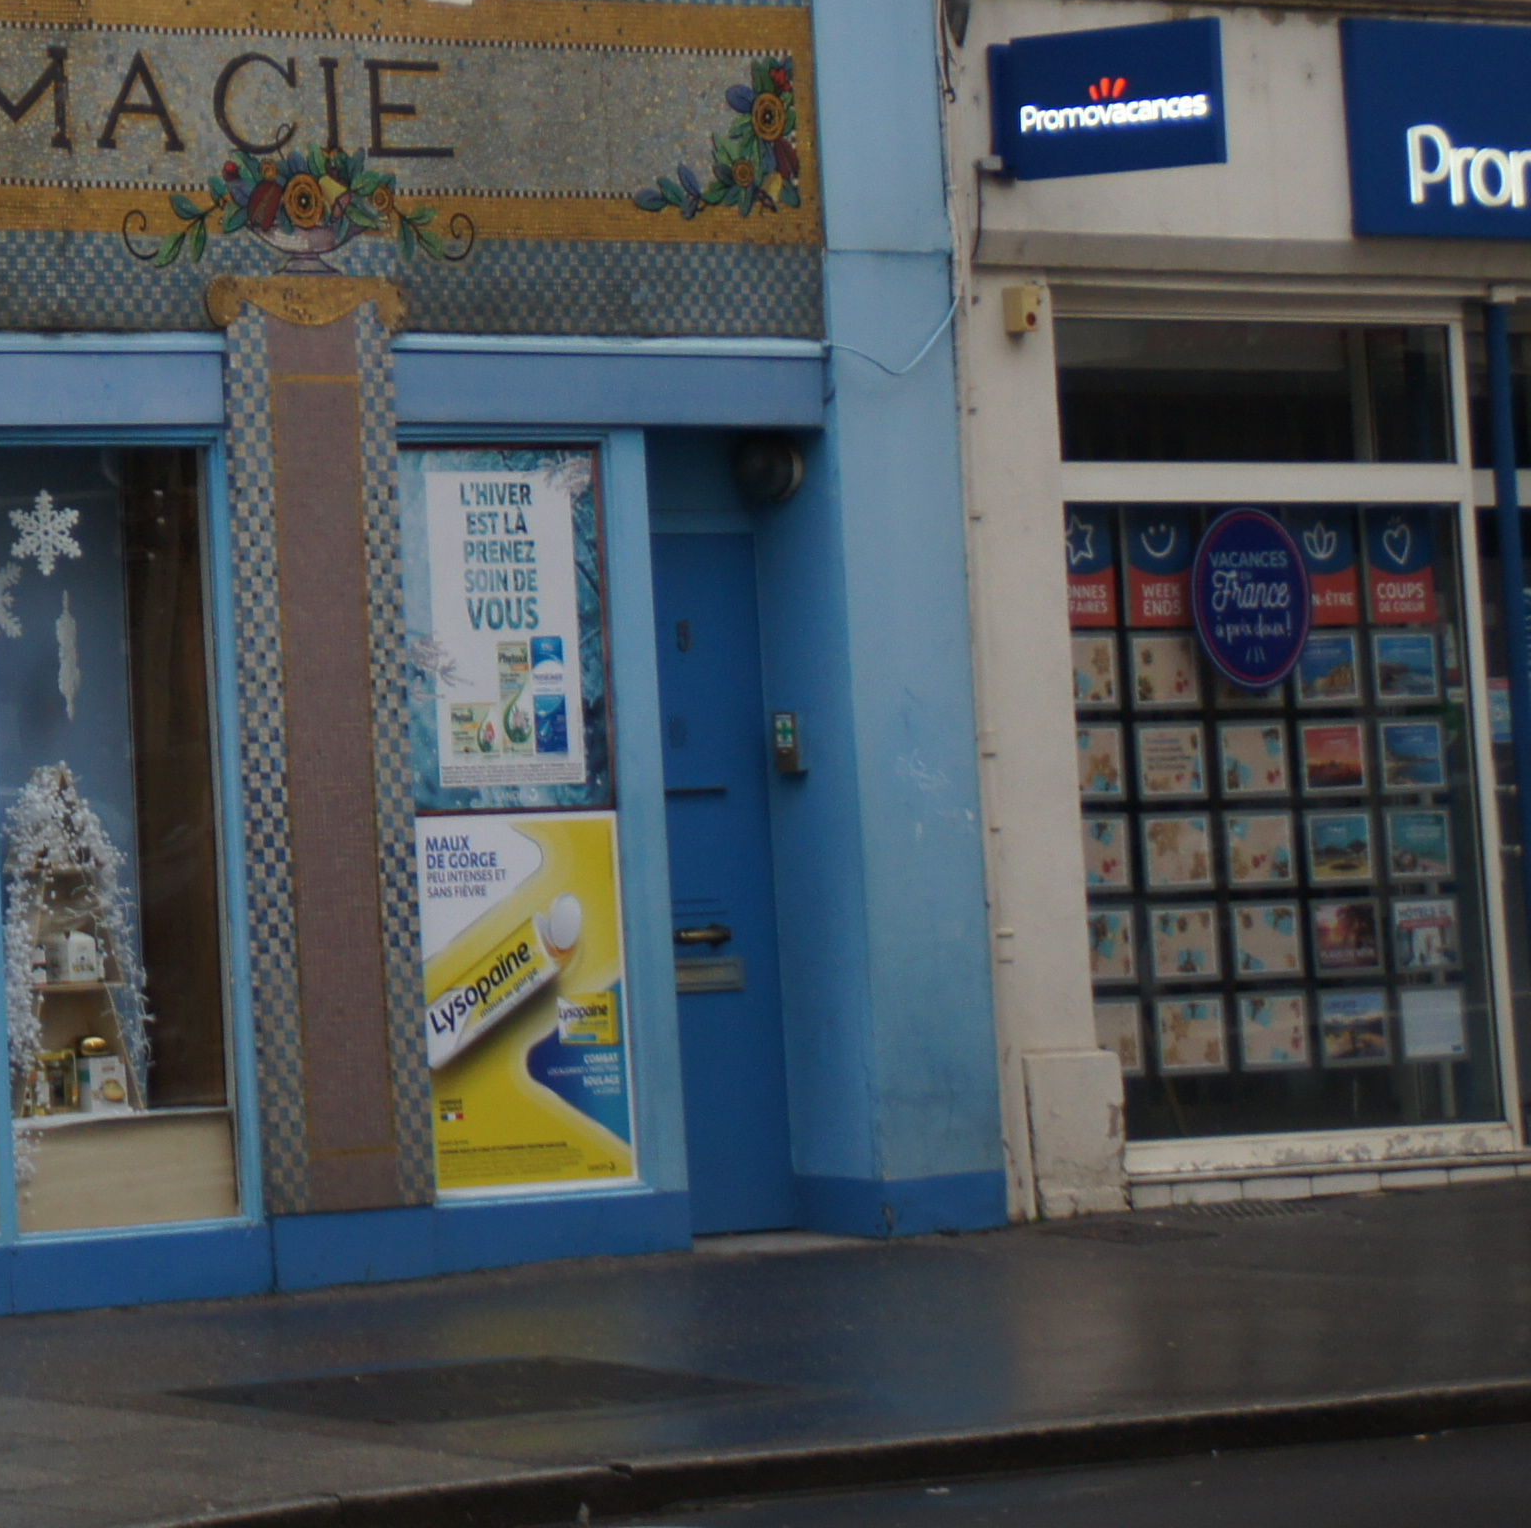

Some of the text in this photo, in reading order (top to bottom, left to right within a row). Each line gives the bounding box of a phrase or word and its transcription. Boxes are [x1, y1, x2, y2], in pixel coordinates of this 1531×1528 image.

[1019, 92, 1210, 134] Promovacances
[459, 482, 532, 507] L'HIVER
[466, 507, 527, 535] EST LÀ
[464, 540, 535, 563] PRENEZ
[1209, 551, 1288, 568] VACANCES
[464, 569, 538, 593] SOIN DE
[1142, 583, 1181, 598] WEEK
[1211, 570, 1289, 612] France
[1377, 582, 1425, 599] COUPS
[466, 596, 539, 631] VOUS
[1143, 600, 1182, 616] ENDS
[1393, 600, 1426, 613] COEUR
[425, 835, 470, 851] MAUX
[426, 851, 497, 869] DE GORGE
[427, 868, 507, 884] PEU INTENSES ET
[427, 882, 487, 899] SANS FIÈVRE
[429, 941, 532, 1035] Lysopaïne
